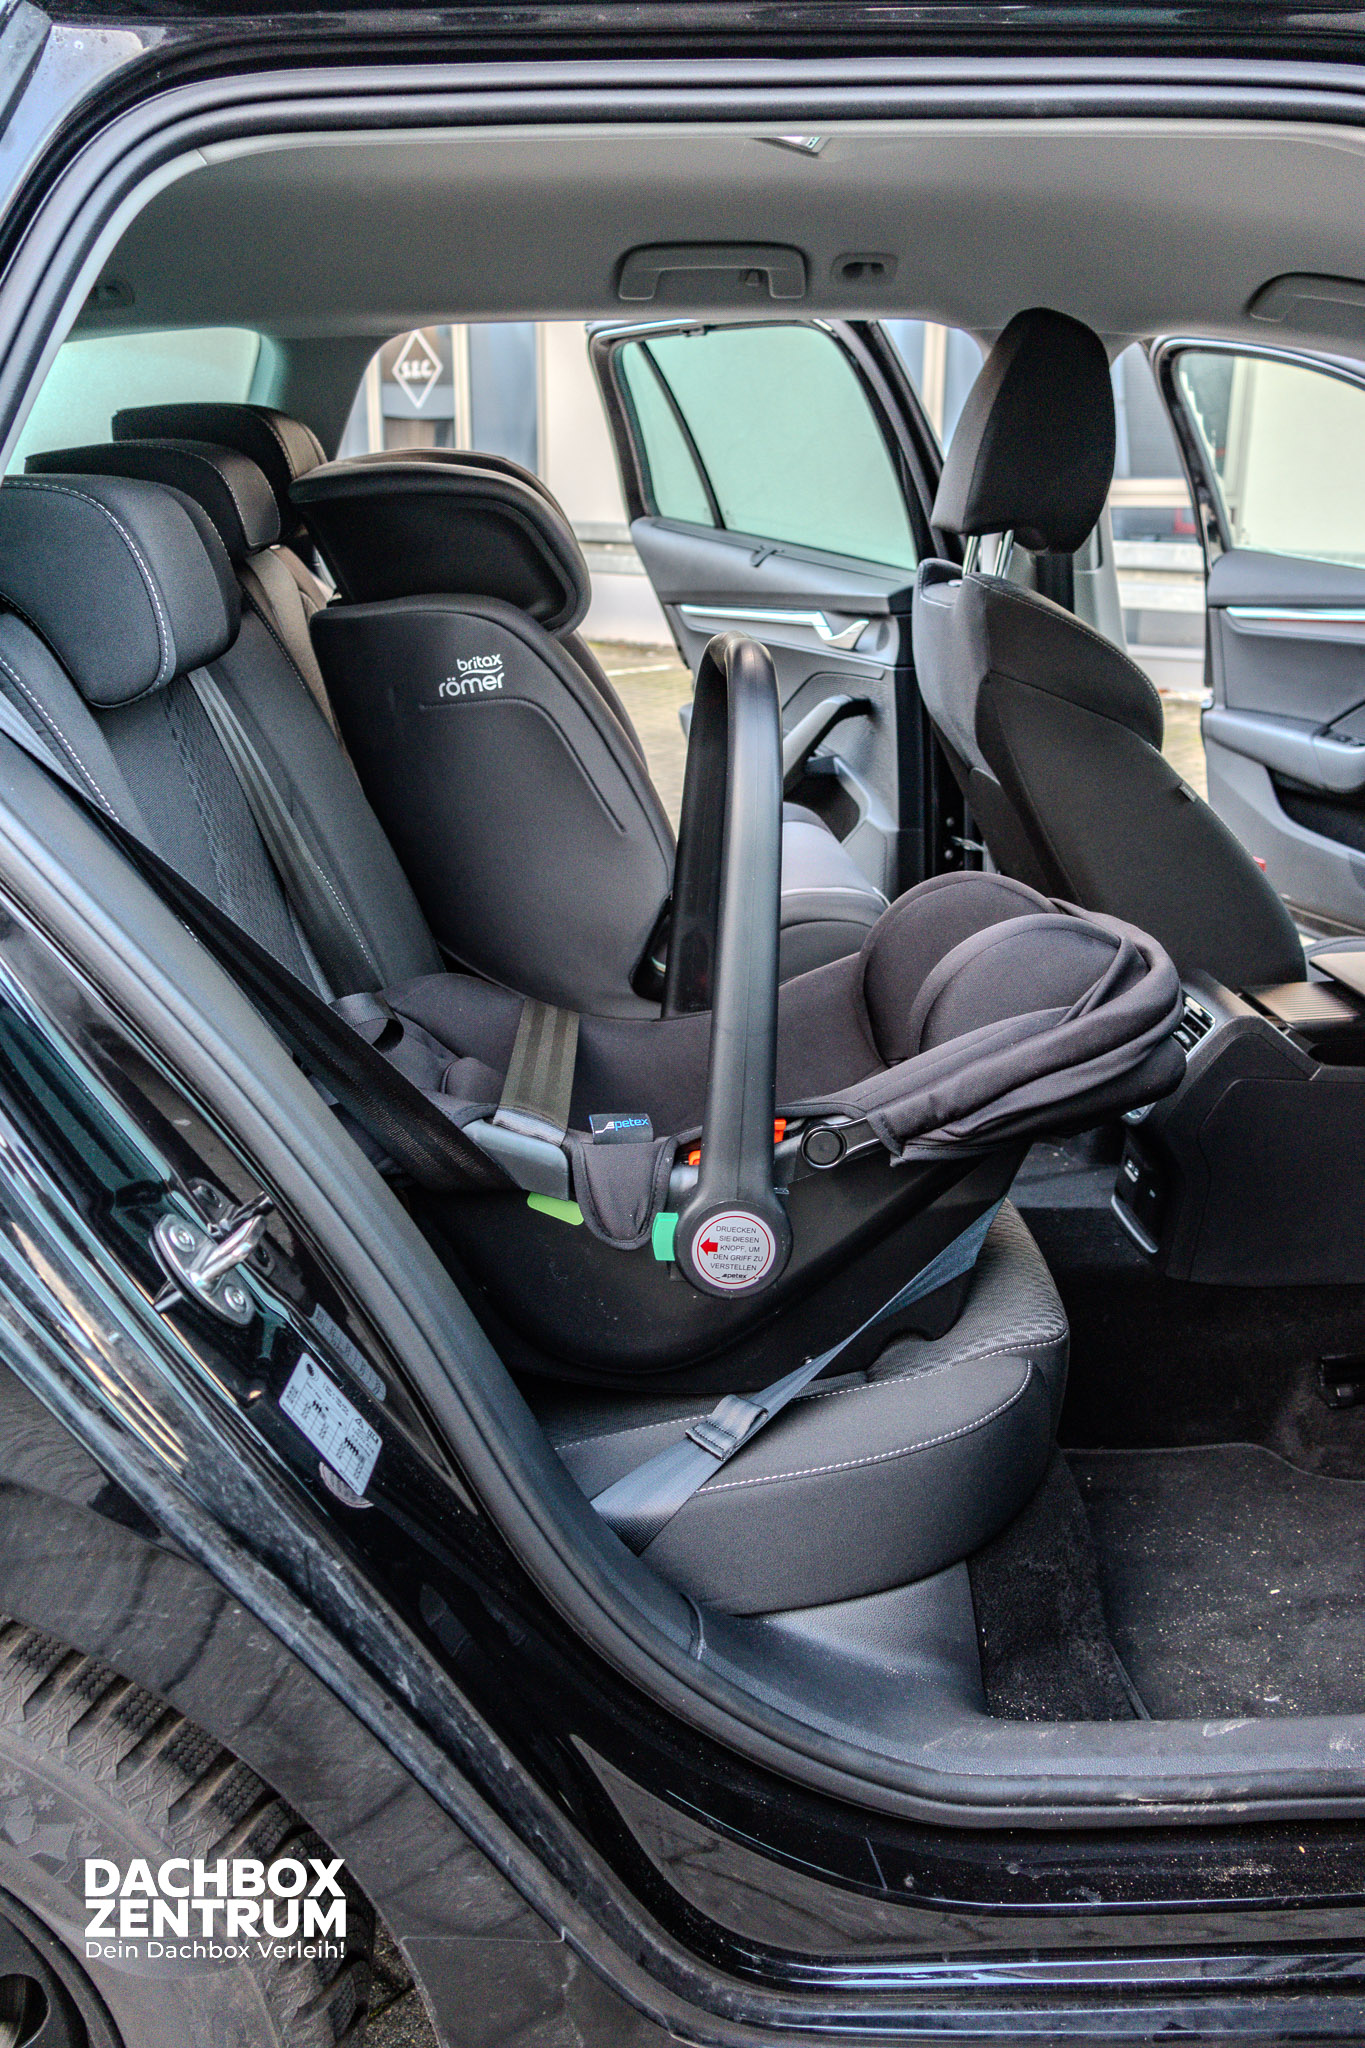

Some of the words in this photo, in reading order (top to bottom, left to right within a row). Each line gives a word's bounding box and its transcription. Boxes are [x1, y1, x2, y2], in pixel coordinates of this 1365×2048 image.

[456, 653, 503, 671] britax
[438, 672, 505, 697] römer
[715, 1225, 757, 1234] DRUECKEN
[732, 1236, 760, 1244] DIESEN
[720, 1244, 747, 1253] KNOPF,
[713, 1253, 729, 1261] DEN
[730, 1254, 752, 1262] GRIFF
[710, 1262, 757, 1271] VERSTELLEN
